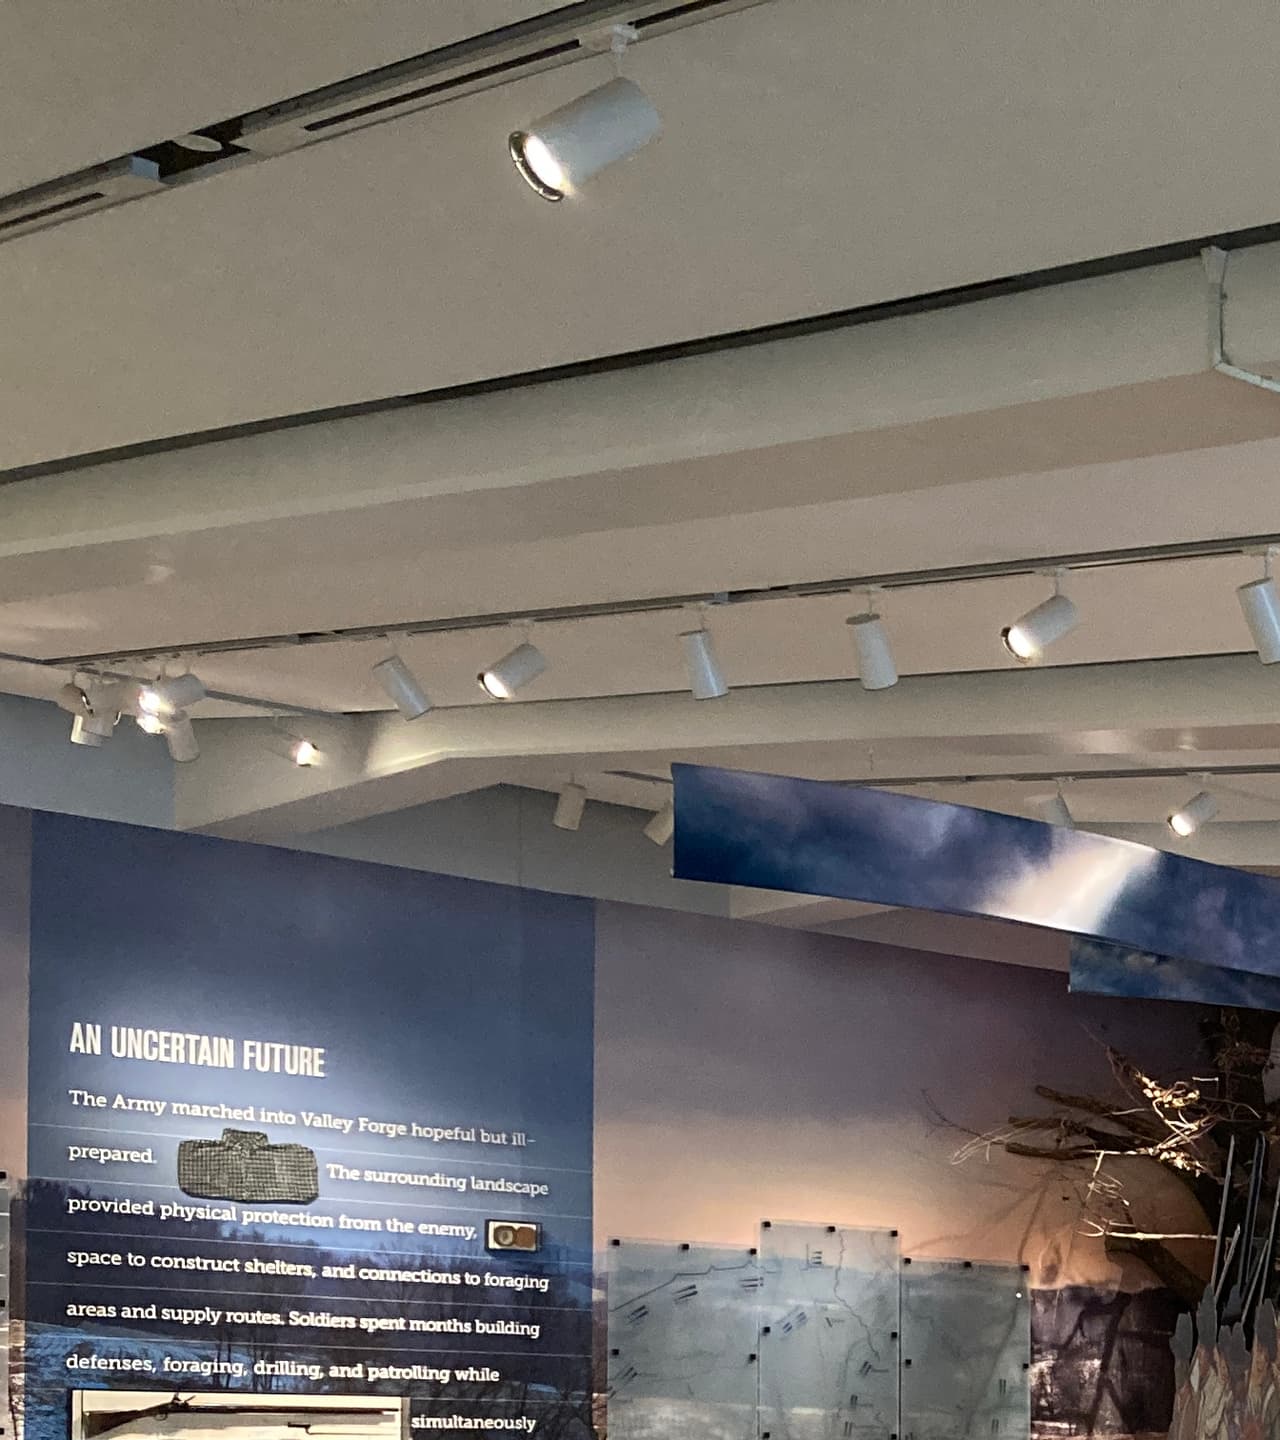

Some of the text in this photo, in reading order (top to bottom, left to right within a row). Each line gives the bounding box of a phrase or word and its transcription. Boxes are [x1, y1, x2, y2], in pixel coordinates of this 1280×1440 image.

[69, 1022, 326, 1078] AN UNCERTAIN FUTURE
[68, 1090, 107, 1108] The
[112, 1094, 166, 1117] Army
[171, 1100, 255, 1122] marched
[260, 1109, 296, 1126] into
[300, 1111, 353, 1134] Valley
[358, 1116, 407, 1139] Forge
[411, 1122, 476, 1144] hopeful
[479, 1128, 507, 1144] but
[326, 1163, 548, 1198] The surrounding landscape
[67, 1196, 155, 1216] provided
[160, 1201, 237, 1222] physical
[241, 1209, 334, 1229] protection
[338, 1214, 382, 1231] from
[386, 1218, 415, 1234] the
[67, 1251, 121, 1269] space
[127, 1252, 146, 1267] to
[150, 1253, 240, 1272] construct
[321, 1262, 357, 1279] and
[358, 1262, 461, 1284] connections
[464, 1271, 480, 1285] to
[483, 1271, 549, 1292] foraging
[66, 1304, 116, 1317] areas
[120, 1303, 156, 1319] and
[161, 1304, 222, 1325] supply
[288, 1310, 357, 1329] Soldiers
[359, 1315, 406, 1334] spent
[408, 1316, 472, 1333] months
[474, 1318, 540, 1339] building
[328, 1362, 364, 1378] and
[367, 1364, 450, 1383] patrolling
[454, 1366, 499, 1381] while
[411, 1415, 536, 1435] simultaneously
